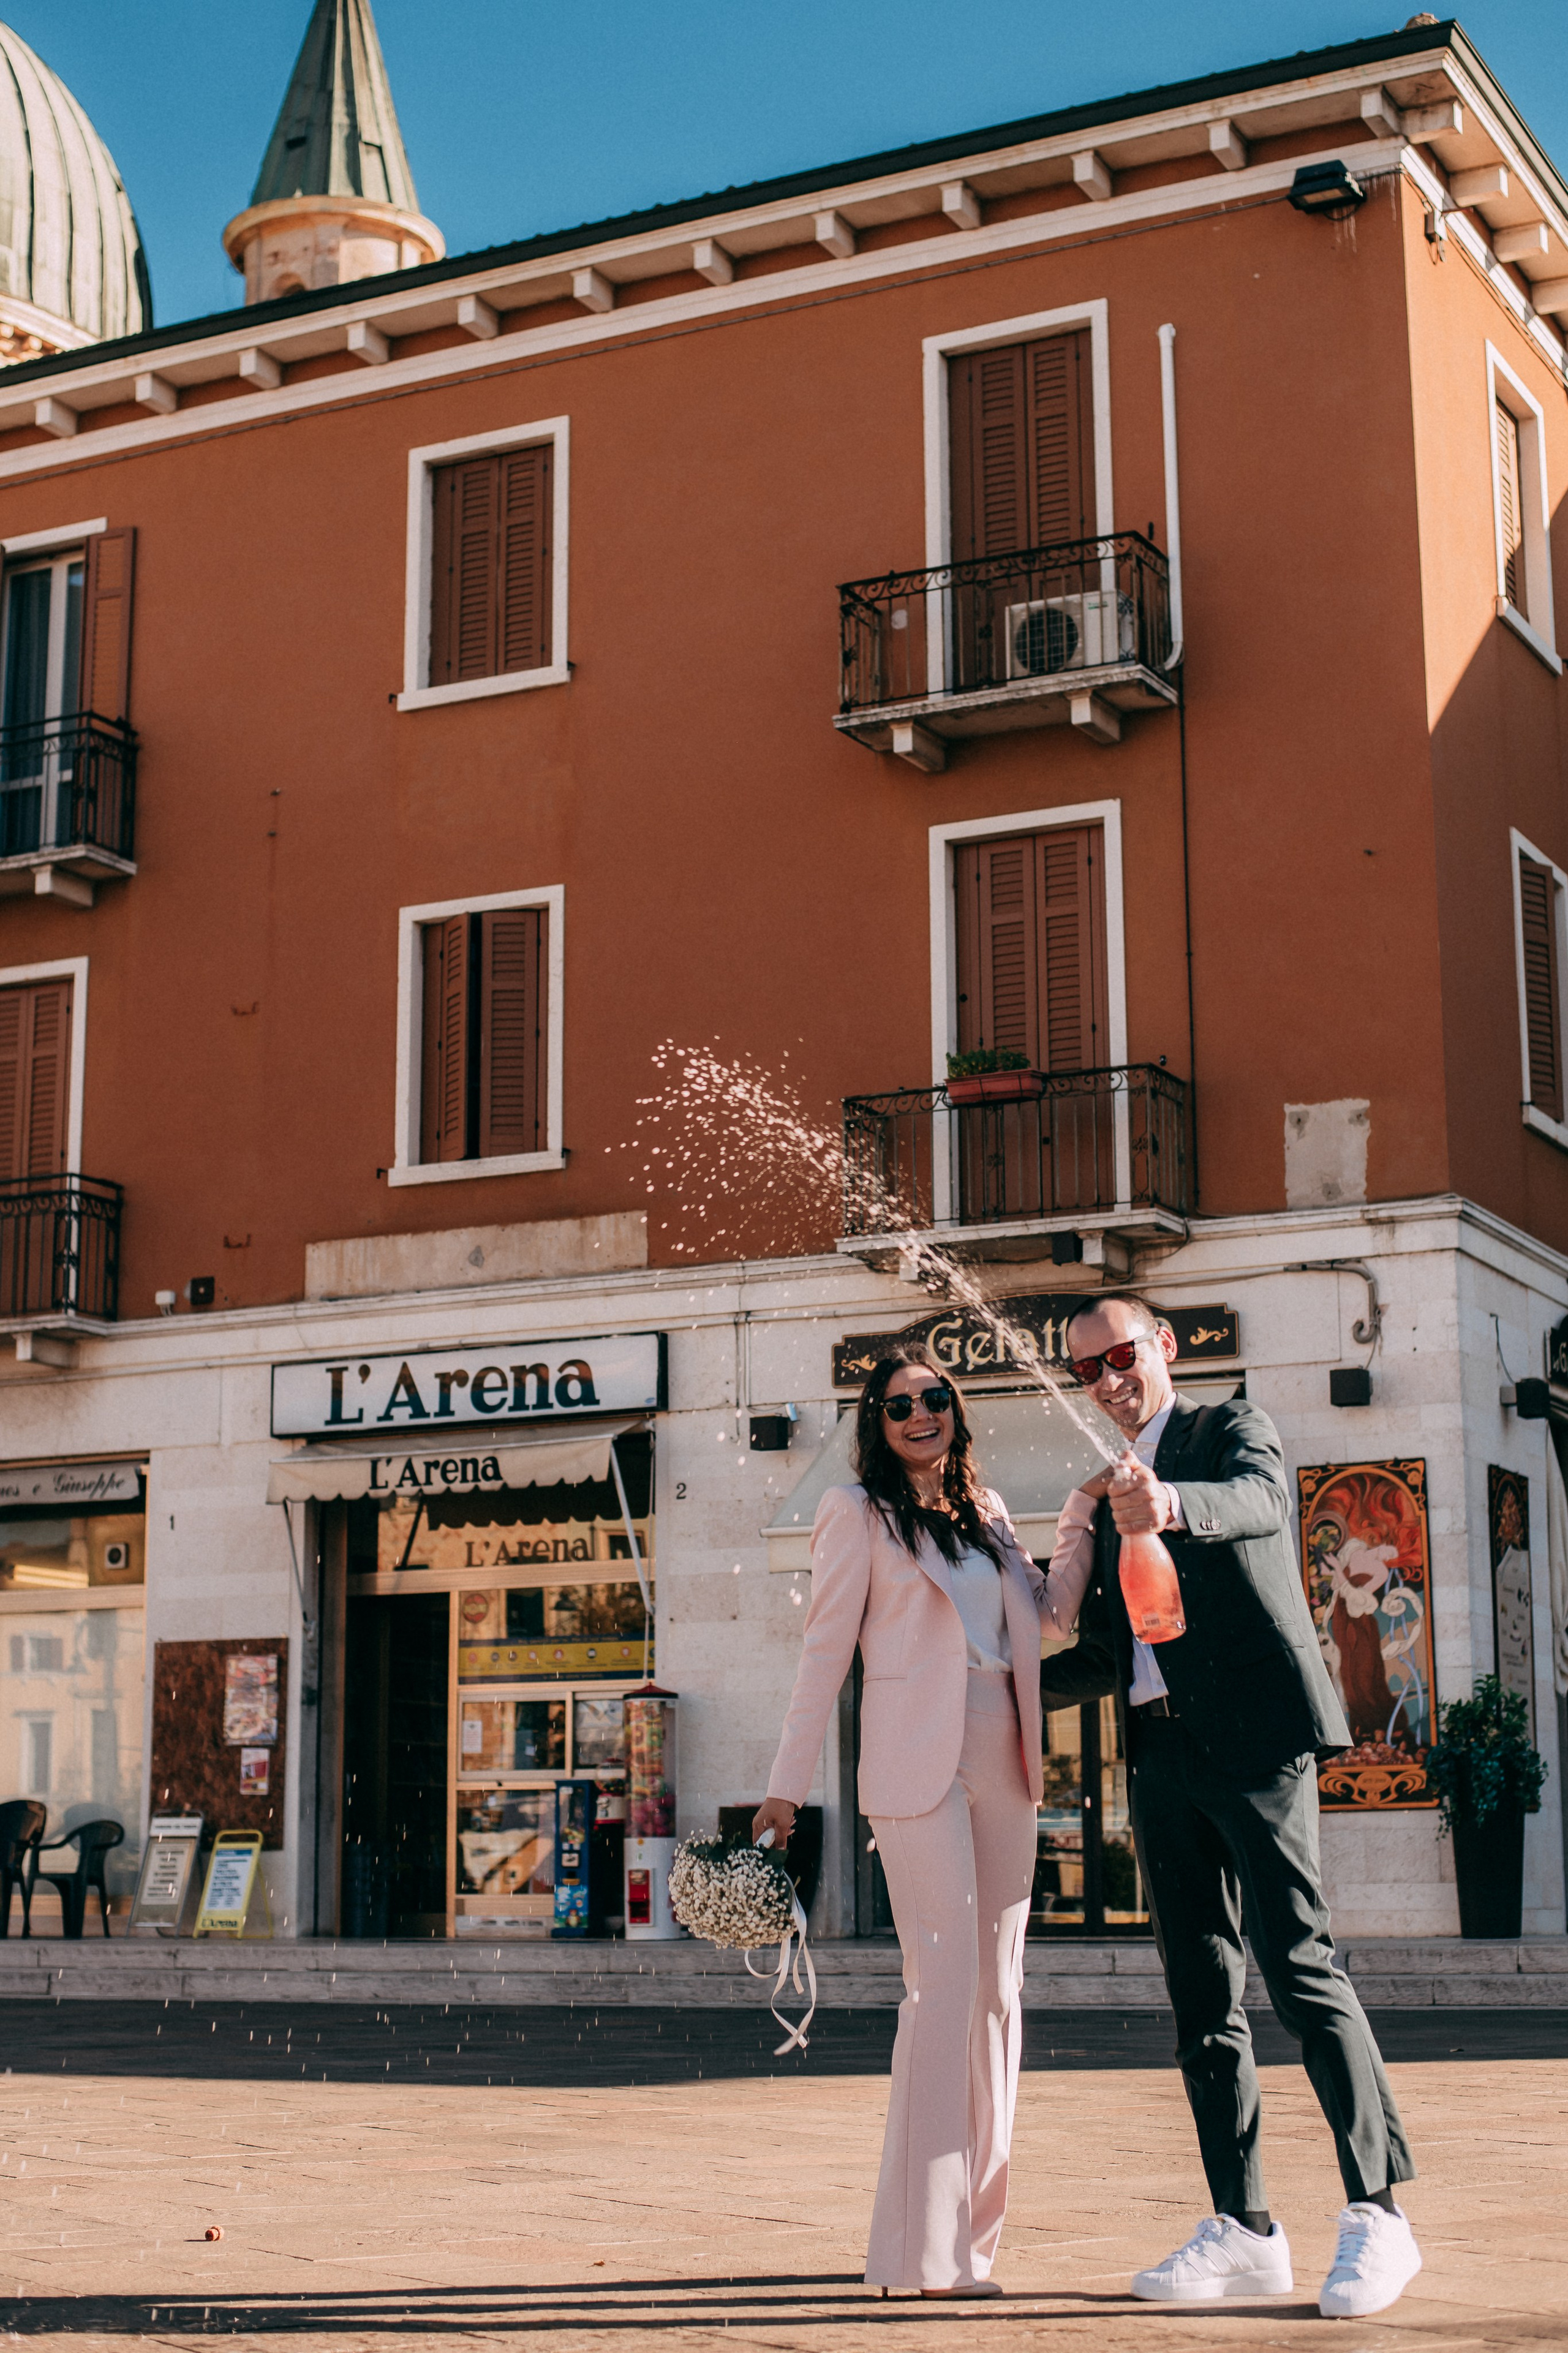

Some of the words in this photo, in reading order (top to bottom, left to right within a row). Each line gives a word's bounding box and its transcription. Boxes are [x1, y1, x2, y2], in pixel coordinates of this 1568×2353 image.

[325, 1358, 600, 1426] L'Arena
[54, 1471, 125, 1499] Giuseppe
[369, 1456, 503, 1490] L'Arena
[676, 1482, 687, 1500] 2
[466, 1538, 590, 1568] L'Arena
